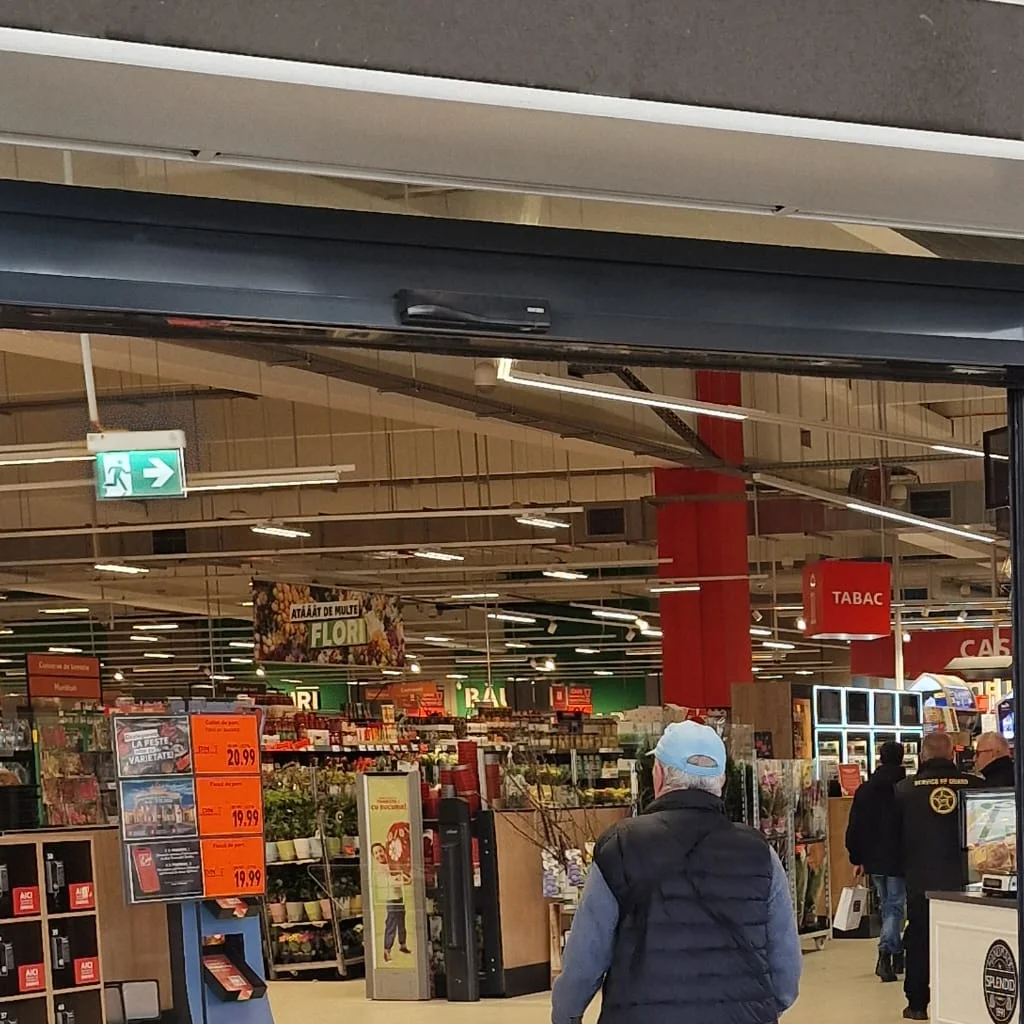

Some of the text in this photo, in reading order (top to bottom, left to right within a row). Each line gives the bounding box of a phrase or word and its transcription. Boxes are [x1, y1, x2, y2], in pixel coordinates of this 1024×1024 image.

[832, 591, 883, 606] TABAC
[323, 603, 333, 617] DE
[334, 602, 358, 616] MULTE
[311, 619, 366, 648] FLORI
[227, 748, 255, 766] 20.99
[232, 809, 259, 828] 19.99
[234, 869, 261, 888] 19.99
